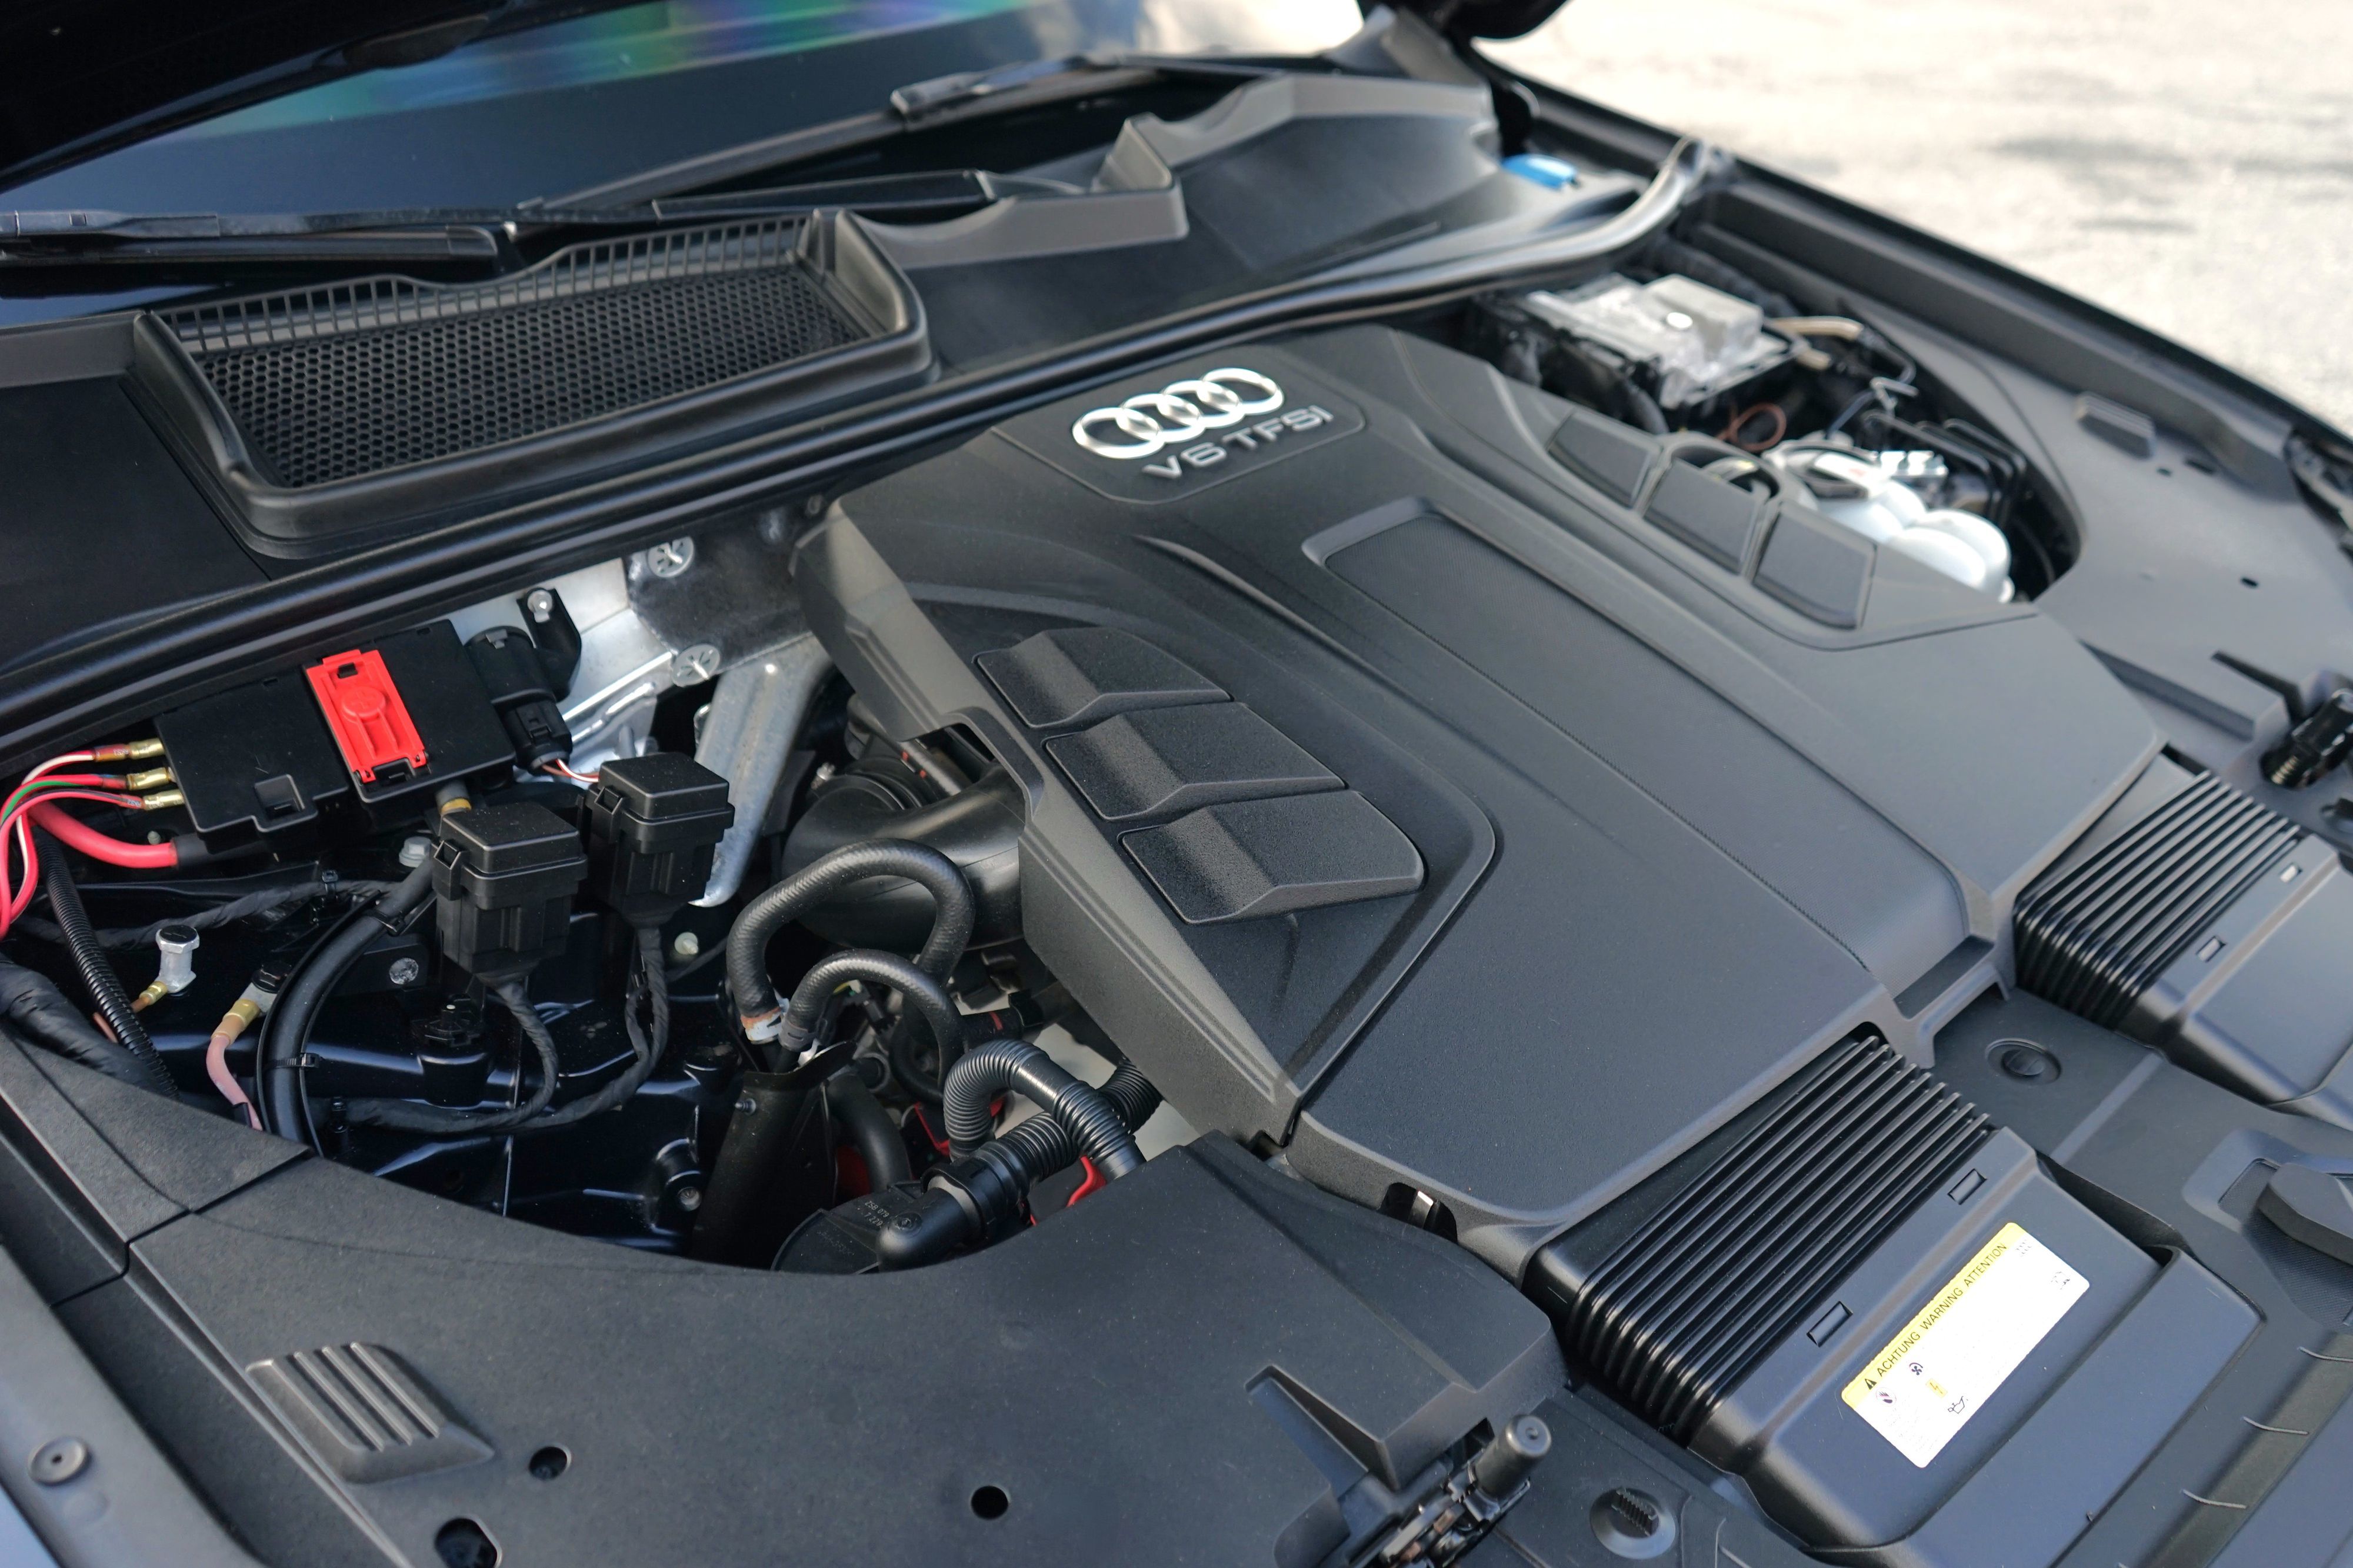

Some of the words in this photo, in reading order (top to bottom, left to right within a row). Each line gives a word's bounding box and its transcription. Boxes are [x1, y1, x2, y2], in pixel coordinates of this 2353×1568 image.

[1142, 442, 1227, 478] V6
[1222, 405, 1334, 450] TFSI
[1877, 1332, 1921, 1377] ACHTUNG
[1920, 1287, 1963, 1330] WARNING
[1964, 1243, 2007, 1287] ATTENTION
